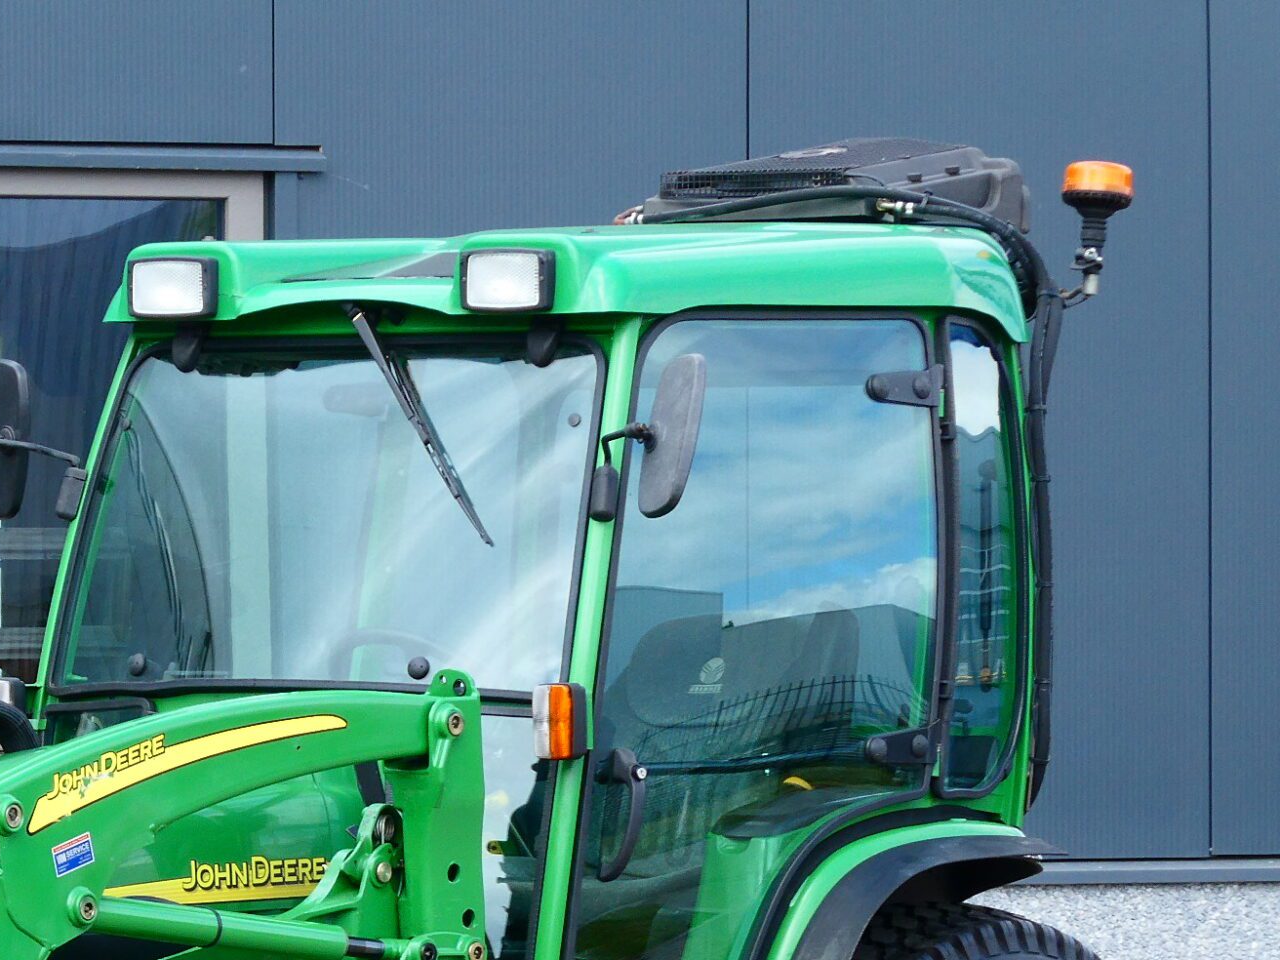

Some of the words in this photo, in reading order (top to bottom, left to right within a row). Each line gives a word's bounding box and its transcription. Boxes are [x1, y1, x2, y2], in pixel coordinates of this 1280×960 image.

[46, 760, 99, 800] JOHN
[100, 733, 166, 775] DEERE
[65, 841, 91, 859] SERVICE
[182, 859, 248, 891] JOHN
[251, 855, 327, 886] DEERE
